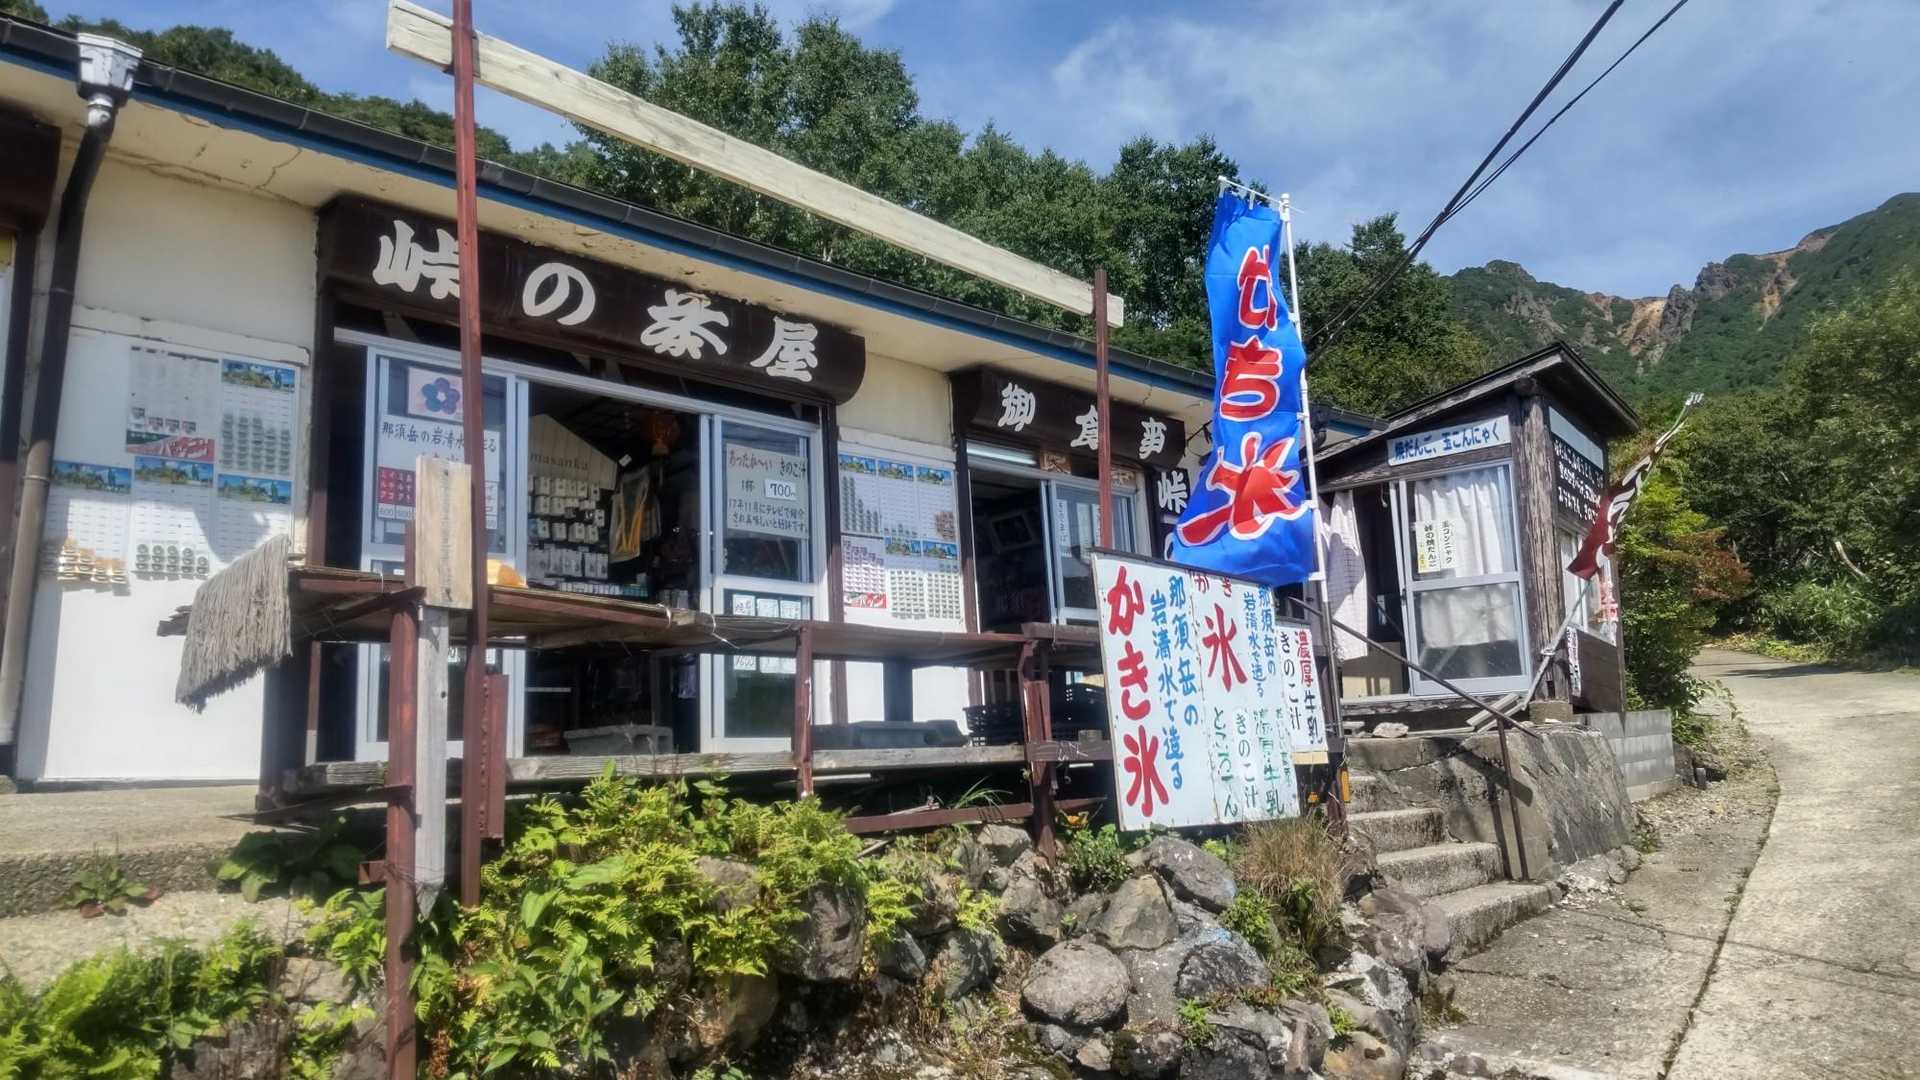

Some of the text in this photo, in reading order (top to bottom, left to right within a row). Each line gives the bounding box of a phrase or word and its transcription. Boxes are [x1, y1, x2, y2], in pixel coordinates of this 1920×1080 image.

[372, 219, 819, 384] 峠の茶屋
[1107, 565, 1170, 817] かき氷
[1150, 589, 1184, 790] 岩清水で造る
[1168, 575, 1199, 727] 那須岳の
[1202, 602, 1248, 693] 氷
[1280, 631, 1302, 730] きのこ汁
